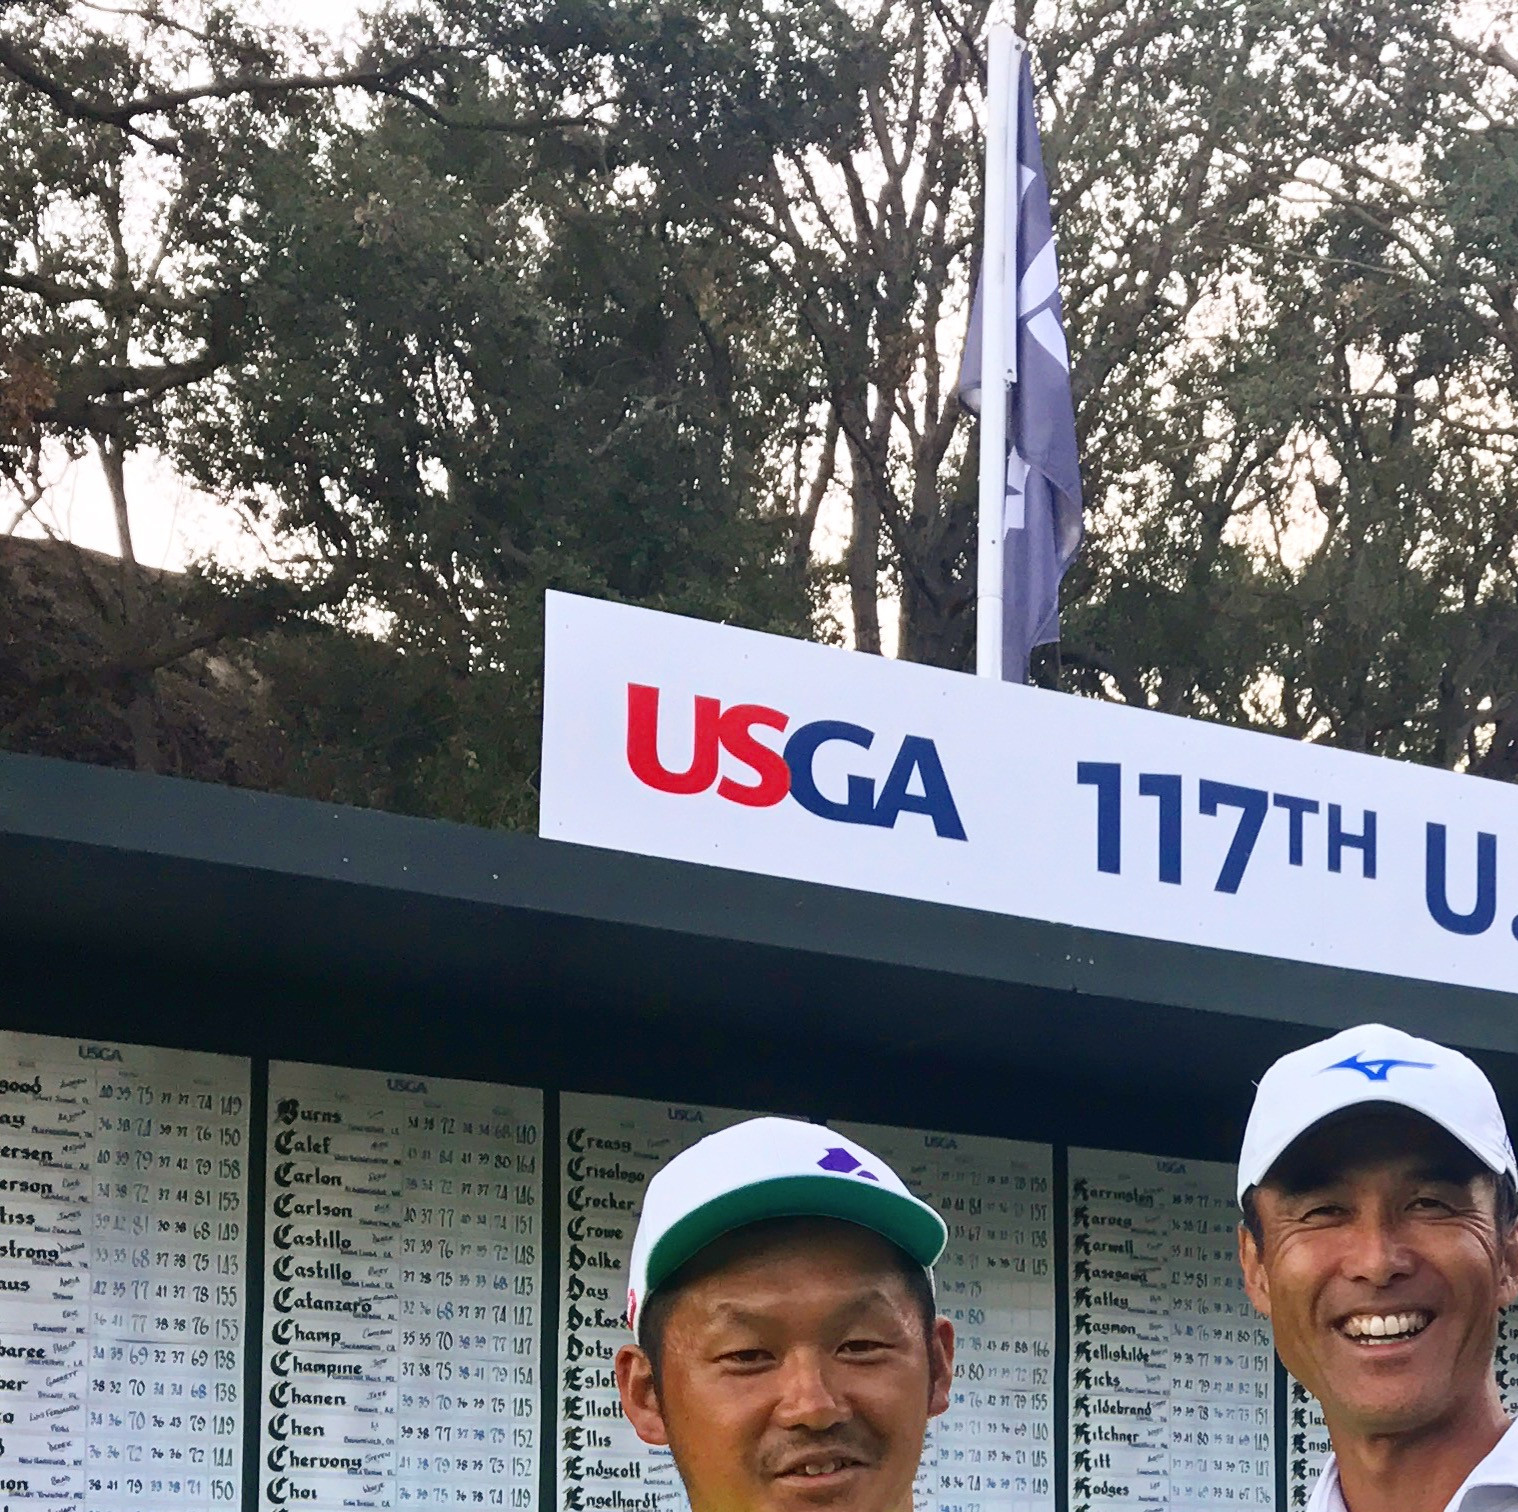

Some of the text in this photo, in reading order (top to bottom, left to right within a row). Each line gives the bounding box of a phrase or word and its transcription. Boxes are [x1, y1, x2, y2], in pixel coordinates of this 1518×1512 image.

[627, 682, 967, 841] USGA
[1076, 761, 1377, 894] 117TH
[273, 1193, 353, 1218] Carlson
[273, 1224, 351, 1250] Castillo
[273, 1256, 351, 1282] Castillo
[273, 1287, 372, 1313] Catanzaro
[566, 1273, 608, 1301] Day
[272, 1319, 341, 1346] Champ
[565, 1333, 613, 1362] Doty
[271, 1351, 362, 1377] Champine
[269, 1381, 346, 1408] Chanen
[268, 1413, 324, 1440] Chen
[562, 1426, 612, 1450] Ellis
[267, 1445, 362, 1472] Chervony
[267, 1477, 317, 1504] Choi
